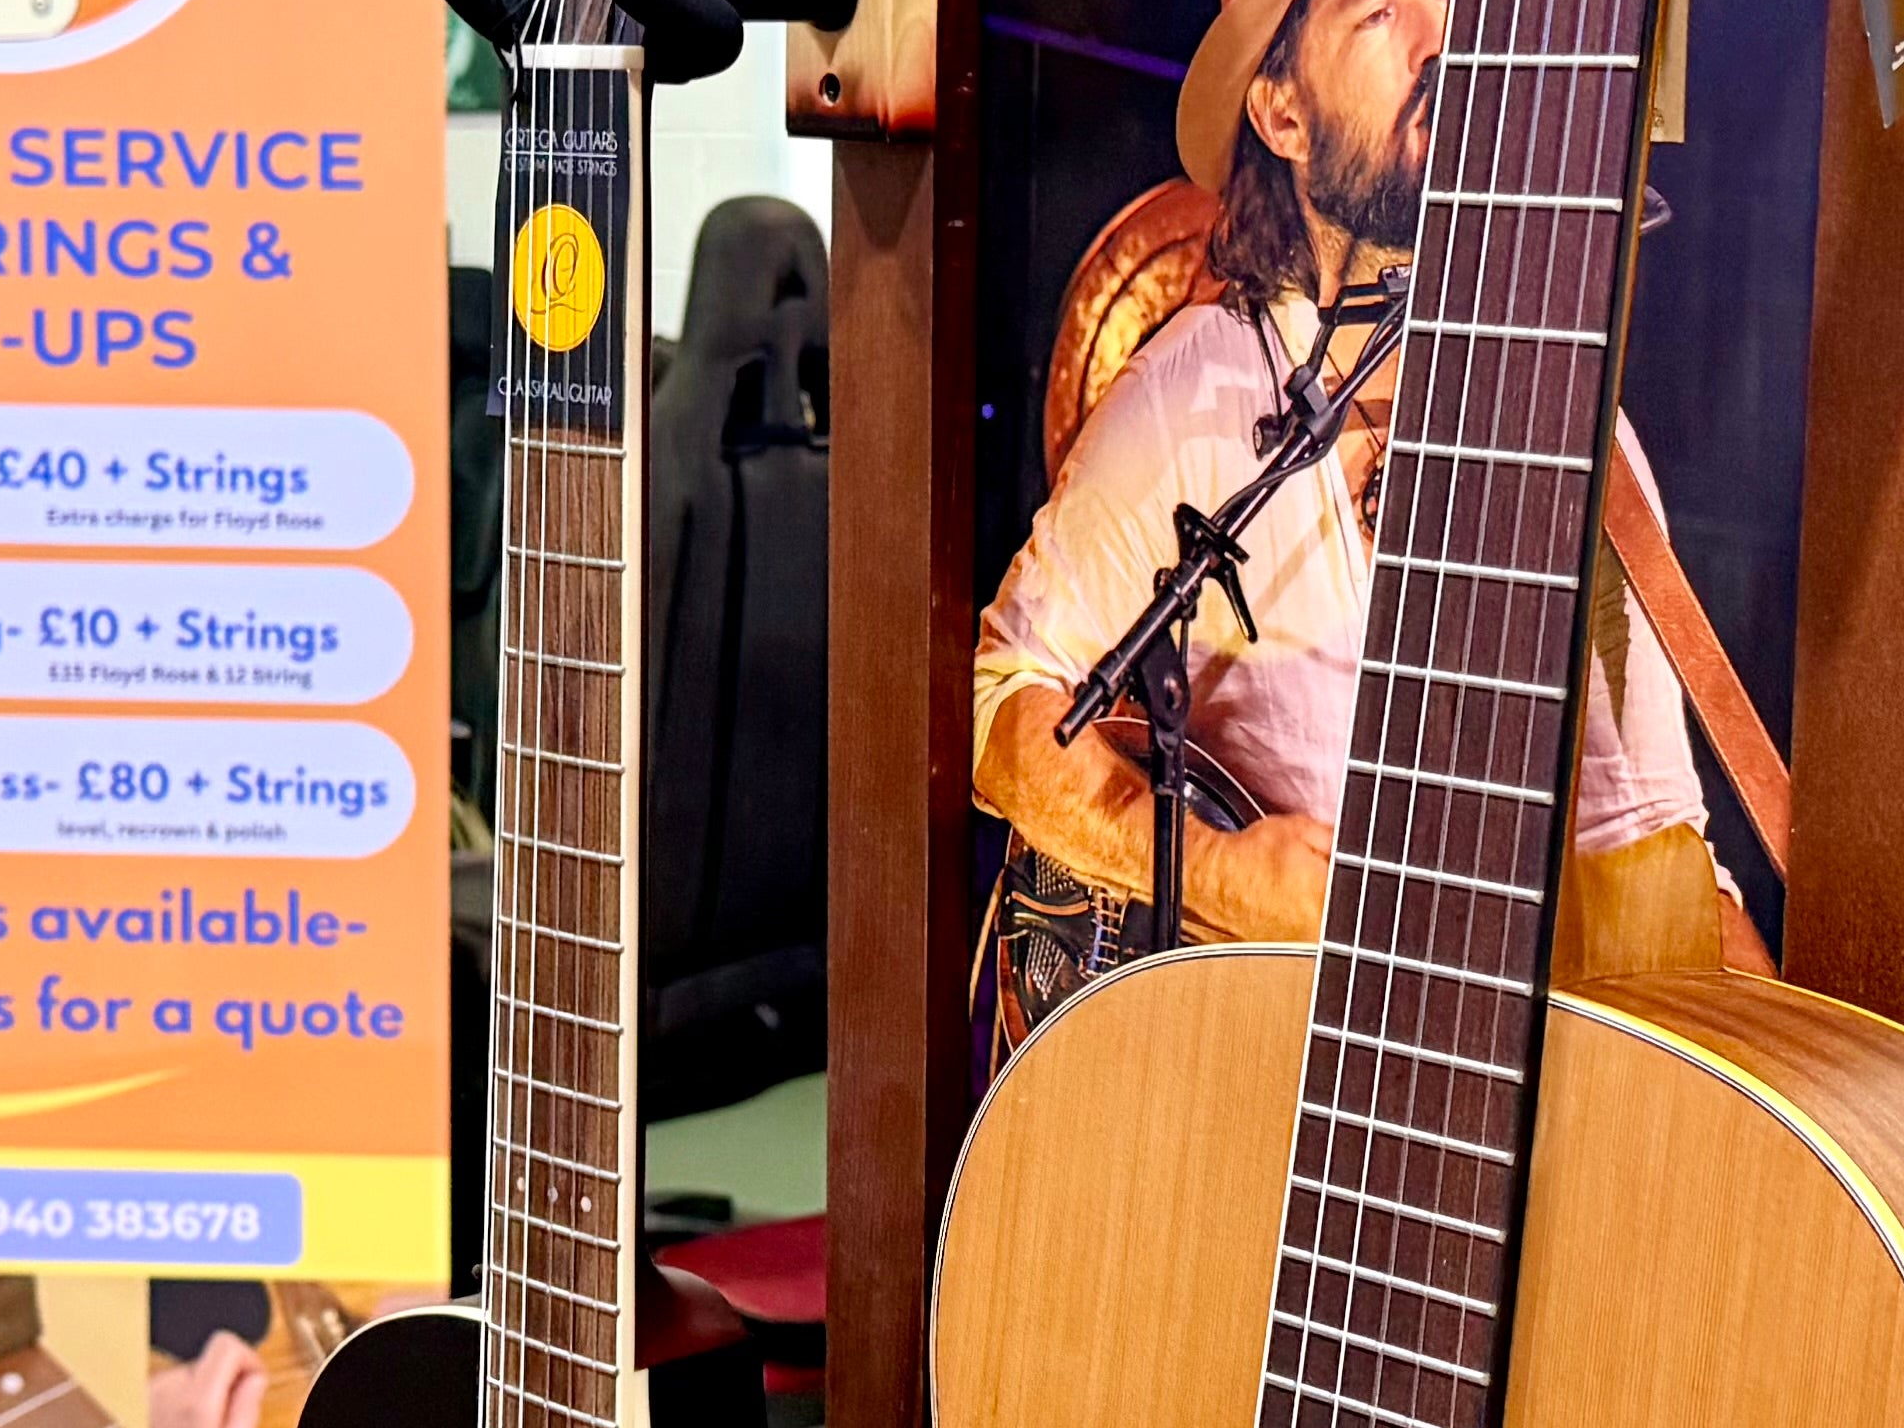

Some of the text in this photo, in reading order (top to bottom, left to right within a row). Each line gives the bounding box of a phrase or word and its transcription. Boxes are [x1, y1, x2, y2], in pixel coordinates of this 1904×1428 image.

[9, 126, 365, 192] SERVICE
[562, 128, 618, 152] GUITARS
[240, 221, 294, 281] &
[104, 459, 128, 483] +
[144, 450, 310, 504] Strings
[39, 607, 118, 648] £10
[134, 617, 159, 640] +
[177, 608, 341, 662] Strings
[77, 761, 171, 803] £80
[186, 773, 210, 797] +
[226, 764, 390, 817] Strings
[30, 887, 369, 947] available-
[38, 974, 132, 1033] for
[152, 997, 194, 1033] a
[213, 990, 405, 1051] quote
[84, 1199, 262, 1241] 383678
